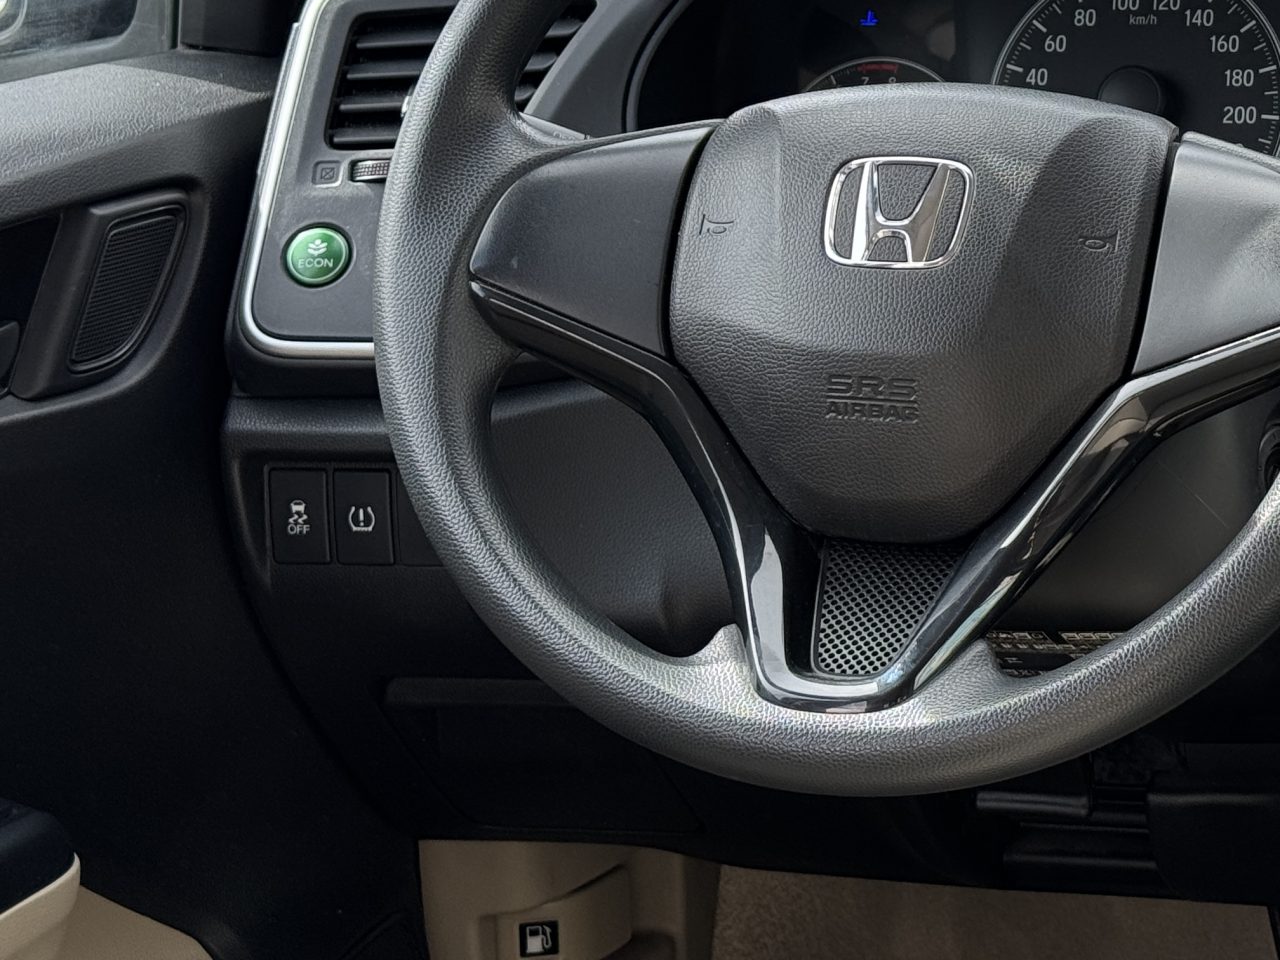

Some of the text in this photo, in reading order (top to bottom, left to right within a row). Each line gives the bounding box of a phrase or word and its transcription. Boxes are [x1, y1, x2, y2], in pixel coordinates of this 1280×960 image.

[1074, 9, 1097, 27] 80
[1129, 14, 1157, 25] km/h
[1184, 9, 1215, 27] 140
[1044, 35, 1067, 53] 60
[1209, 35, 1240, 53] 160
[1025, 68, 1048, 86] 40
[1224, 69, 1255, 87] 180
[1222, 106, 1257, 124] 200
[298, 257, 334, 269] ECON
[826, 375, 917, 400] SRS
[825, 401, 919, 424] AIRBAG
[287, 523, 311, 535] OFF
